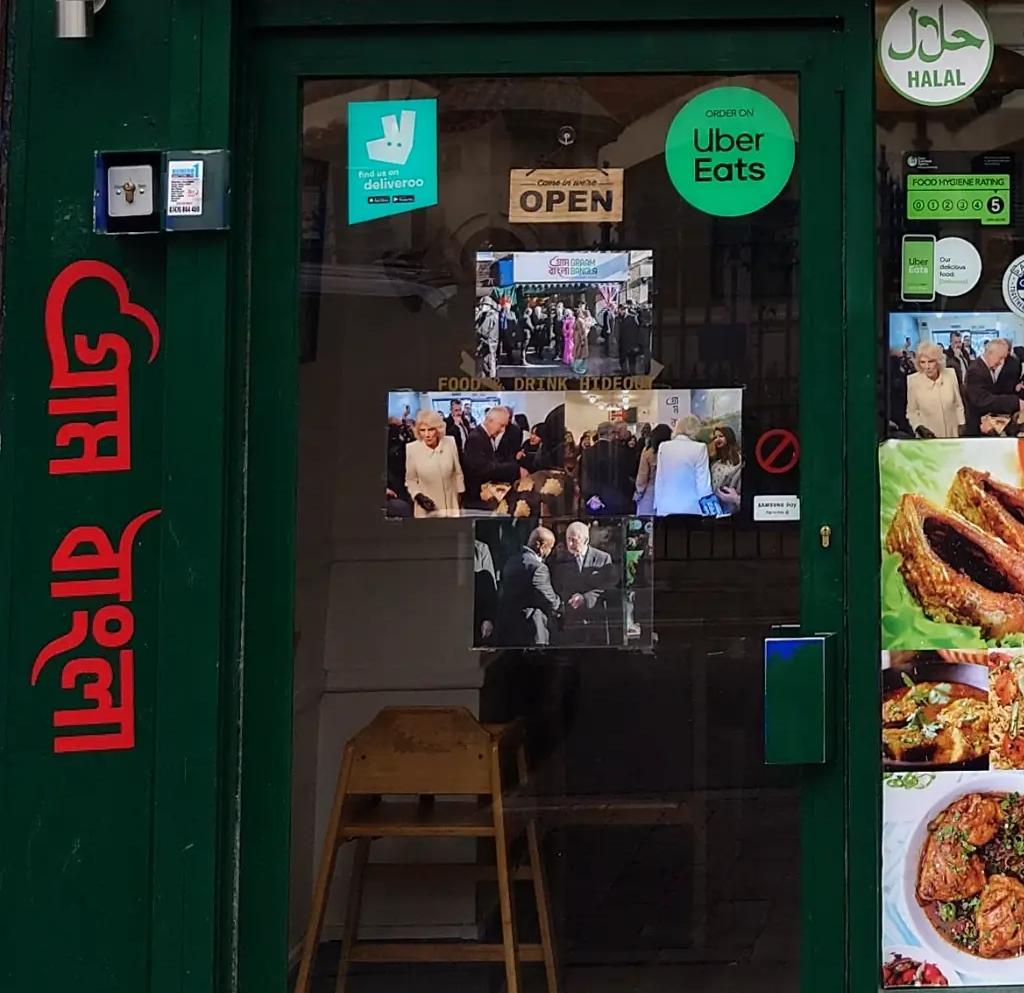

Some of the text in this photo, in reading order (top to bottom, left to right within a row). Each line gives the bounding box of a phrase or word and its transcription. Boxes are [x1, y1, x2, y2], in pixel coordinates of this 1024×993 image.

[888, 4, 985, 62] حلال
[907, 69, 966, 88] HALAL
[705, 109, 754, 118] ORDER ON
[694, 128, 765, 153] Uber
[358, 170, 375, 178] find
[694, 157, 766, 182] Eats
[363, 178, 424, 190] deliveroo
[938, 178, 974, 186] HYGIENE
[974, 178, 1005, 186] RATING
[519, 189, 614, 213] OPEN
[991, 198, 1001, 212] 5
[908, 257, 929, 265] Uber
[908, 266, 929, 274] Eats
[438, 377, 481, 390] FOOD
[513, 377, 567, 391] DRINK
[30, 259, 163, 754] গ্রাম বাংলা
